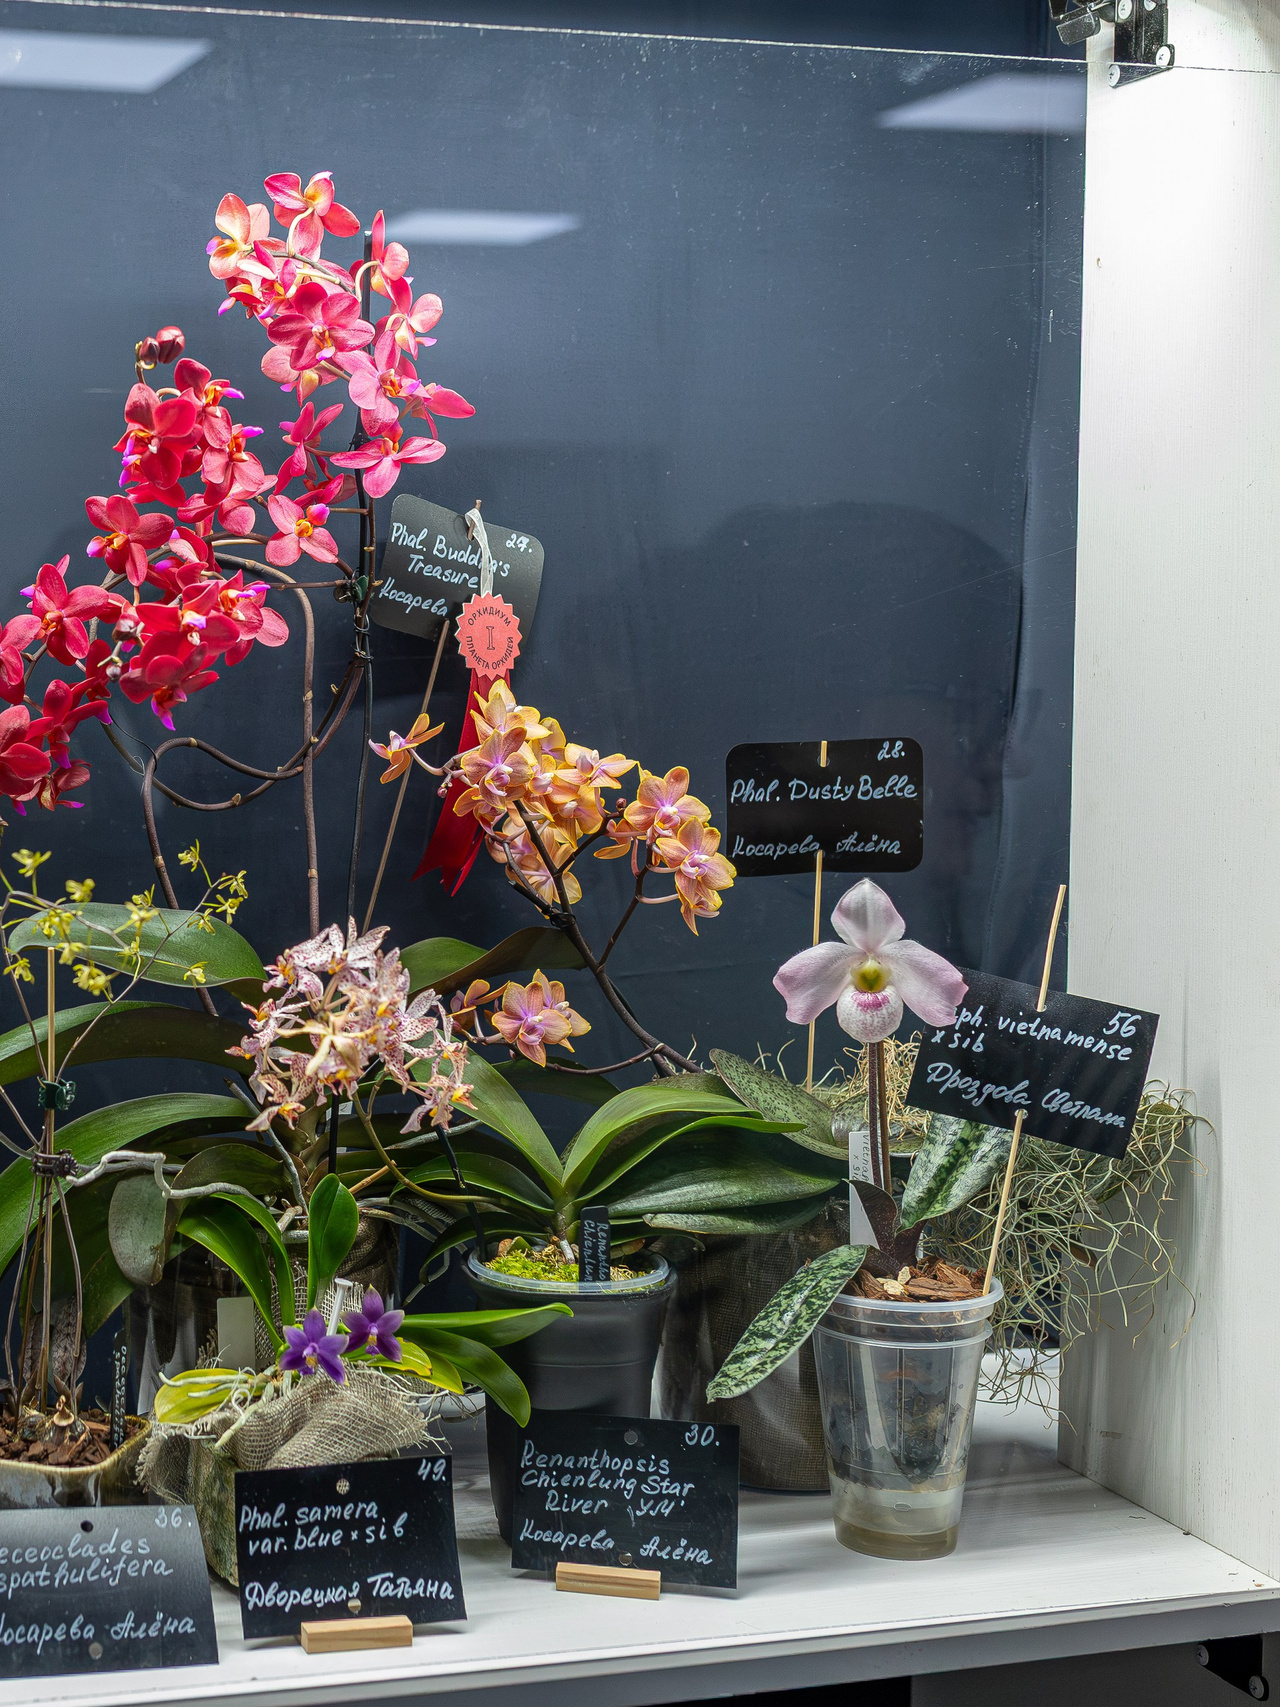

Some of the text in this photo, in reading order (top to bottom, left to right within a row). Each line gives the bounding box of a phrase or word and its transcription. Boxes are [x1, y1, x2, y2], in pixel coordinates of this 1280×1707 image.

[391, 522, 510, 577] Phal. Budda's
[407, 553, 479, 589] Treasure
[379, 577, 448, 617] Косарева
[468, 606, 511, 627] ОРХИДИУМ
[466, 635, 514, 670] ПЛАНЕТА ОРХИДЕЙ
[877, 740, 906, 762] 28.
[731, 774, 918, 803] Phal. Dusty Belle
[732, 831, 901, 860] Косарева Алёна
[954, 1005, 1133, 1061] ph. vietnamense
[1103, 1010, 1143, 1038] 56
[948, 1030, 985, 1053] sib
[926, 1062, 1126, 1129] Дроздова Светлана
[685, 1424, 720, 1447] 30.
[418, 1459, 447, 1482] 49.
[520, 1439, 670, 1477] Renanthopsis
[521, 1469, 695, 1500] Chienlung Star
[154, 1507, 192, 1529] 36.
[239, 1501, 379, 1534] Phal. samera
[545, 1490, 608, 1515] River
[249, 1535, 288, 1556] var.
[294, 1527, 343, 1551] blue
[520, 1518, 713, 1565] Косарева Алёна
[245, 1572, 455, 1613] Дворецкая Татьяна
[110, 1610, 196, 1641] Алёна
